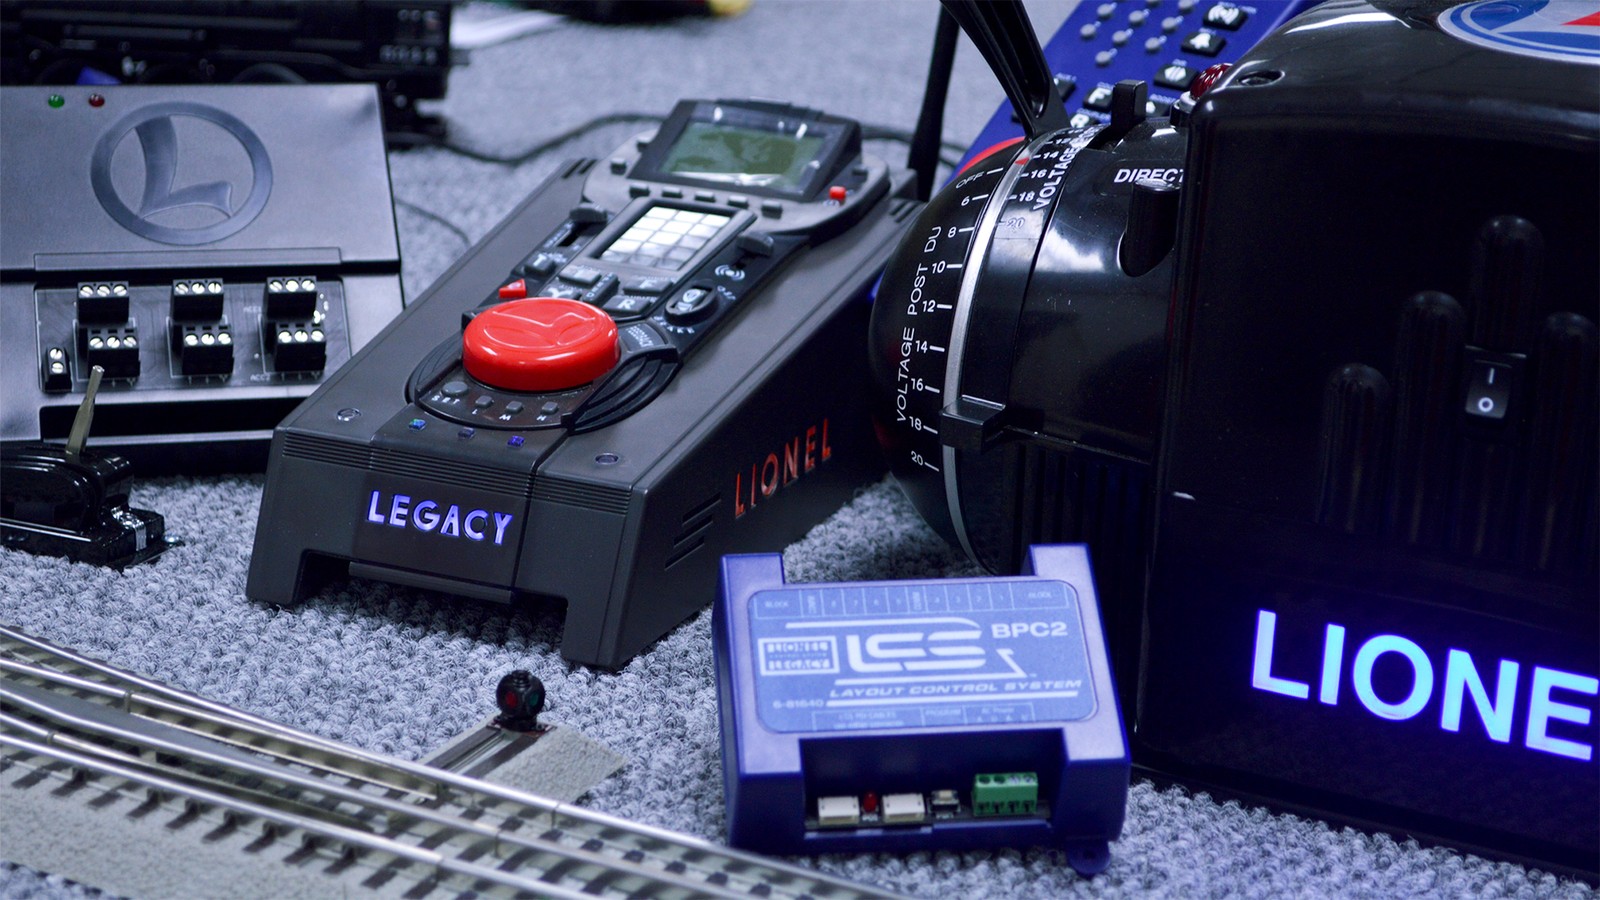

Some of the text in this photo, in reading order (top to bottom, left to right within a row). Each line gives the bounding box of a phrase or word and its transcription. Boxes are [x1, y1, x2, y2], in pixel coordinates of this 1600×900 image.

[1031, 169, 1047, 178] 16
[1033, 148, 1080, 210] VOLTAGE
[956, 172, 984, 189] OFF
[961, 196, 970, 206] 6
[1019, 191, 1035, 201] 18
[1007, 217, 1026, 228] 20
[948, 227, 957, 238] 8
[931, 261, 946, 273] 10
[617, 299, 636, 309] R
[922, 300, 935, 312] 12
[897, 226, 942, 422] VOLTAGE POST DU
[915, 340, 928, 353] 14
[911, 378, 923, 391] 16
[432, 395, 460, 404] SET
[909, 416, 922, 431] 18
[910, 450, 924, 466] 20
[735, 418, 831, 519] LIONEL
[367, 489, 513, 545] LEGACY
[991, 621, 1068, 639] BPC2
[846, 631, 986, 673] LCS
[829, 680, 1082, 698] LAYOUT CONTROL SYSTEM
[1252, 610, 1599, 761] LIONE
[772, 699, 824, 709] 6-81640
